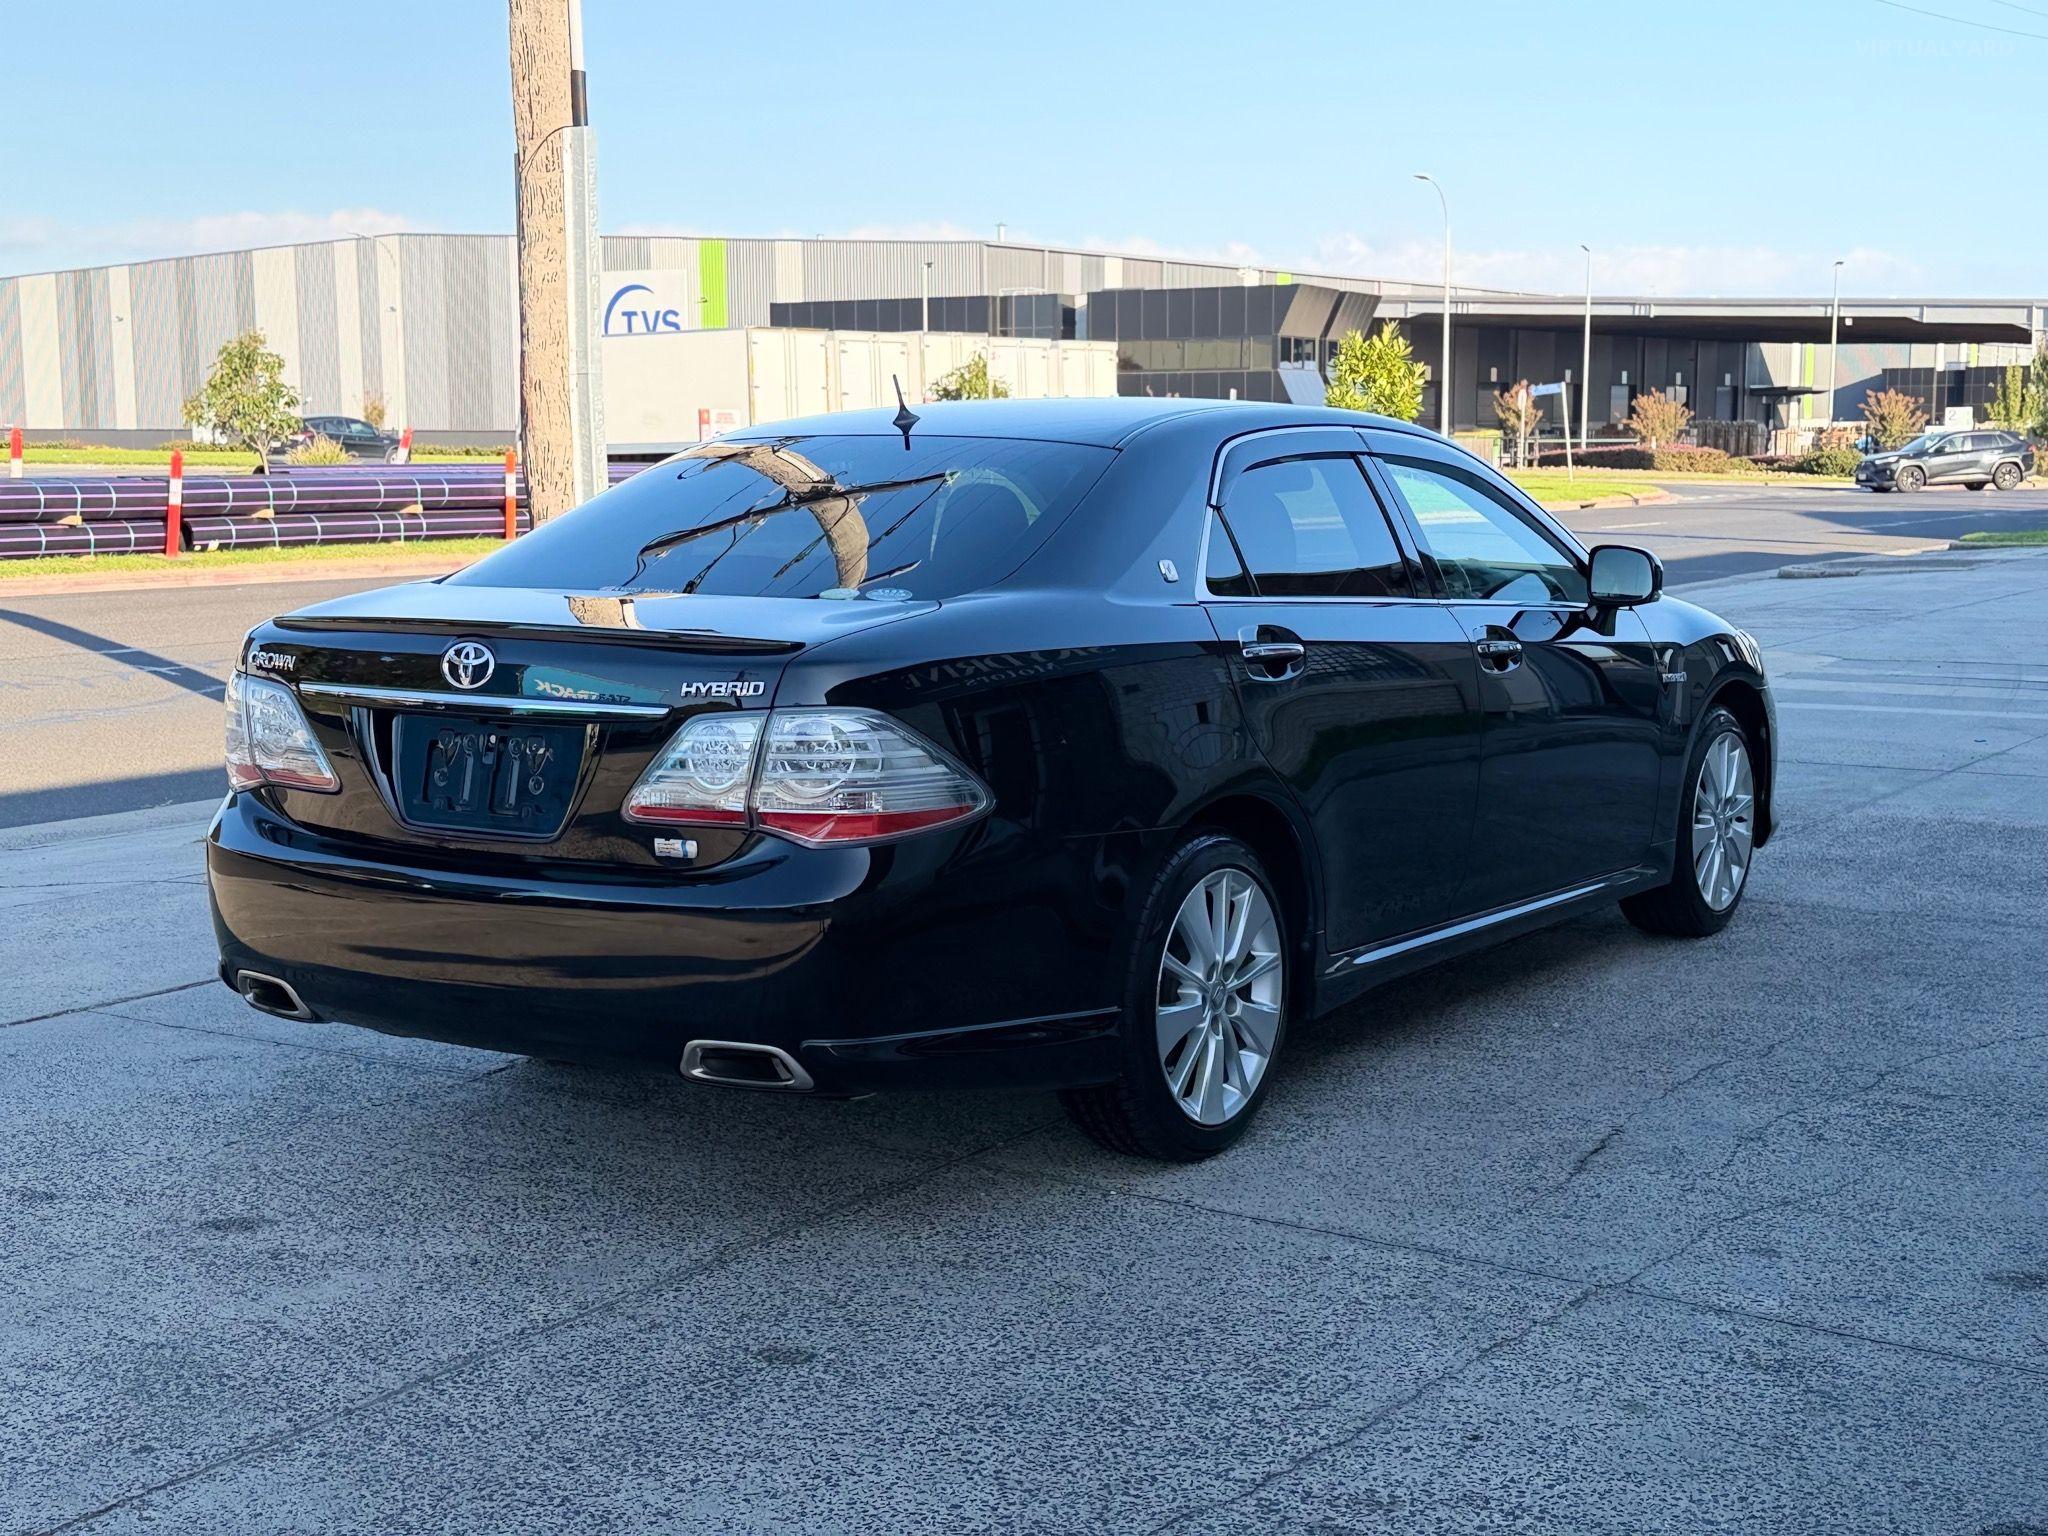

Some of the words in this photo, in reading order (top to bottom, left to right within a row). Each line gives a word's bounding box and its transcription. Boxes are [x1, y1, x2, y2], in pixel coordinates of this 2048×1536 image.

[621, 309, 681, 334] TVS
[249, 651, 296, 671] CROWN
[680, 681, 765, 697] HYBRID
